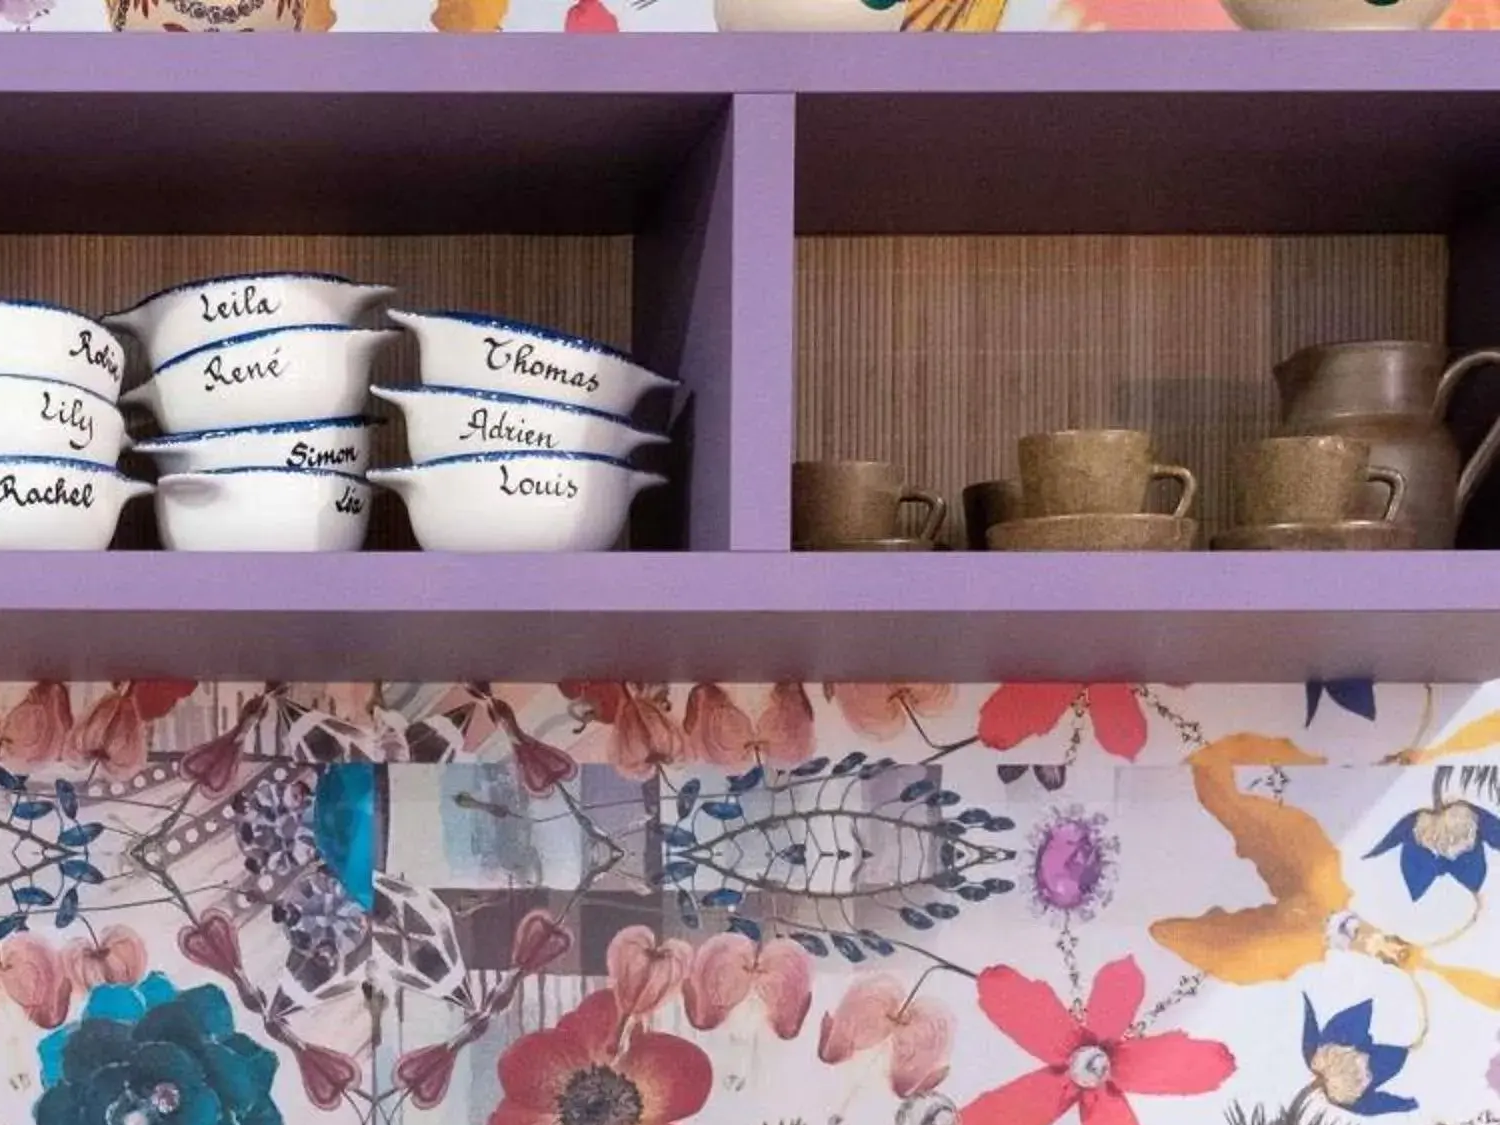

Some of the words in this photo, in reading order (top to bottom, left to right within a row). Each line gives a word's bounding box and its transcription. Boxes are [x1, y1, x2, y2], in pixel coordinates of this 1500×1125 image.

[200, 285, 279, 322] Leila
[203, 346, 287, 391] René
[483, 337, 601, 392] Thomas
[40, 391, 94, 450] Lily
[459, 407, 560, 449] Adrien
[285, 441, 358, 468] Simon
[500, 463, 579, 499] Louis
